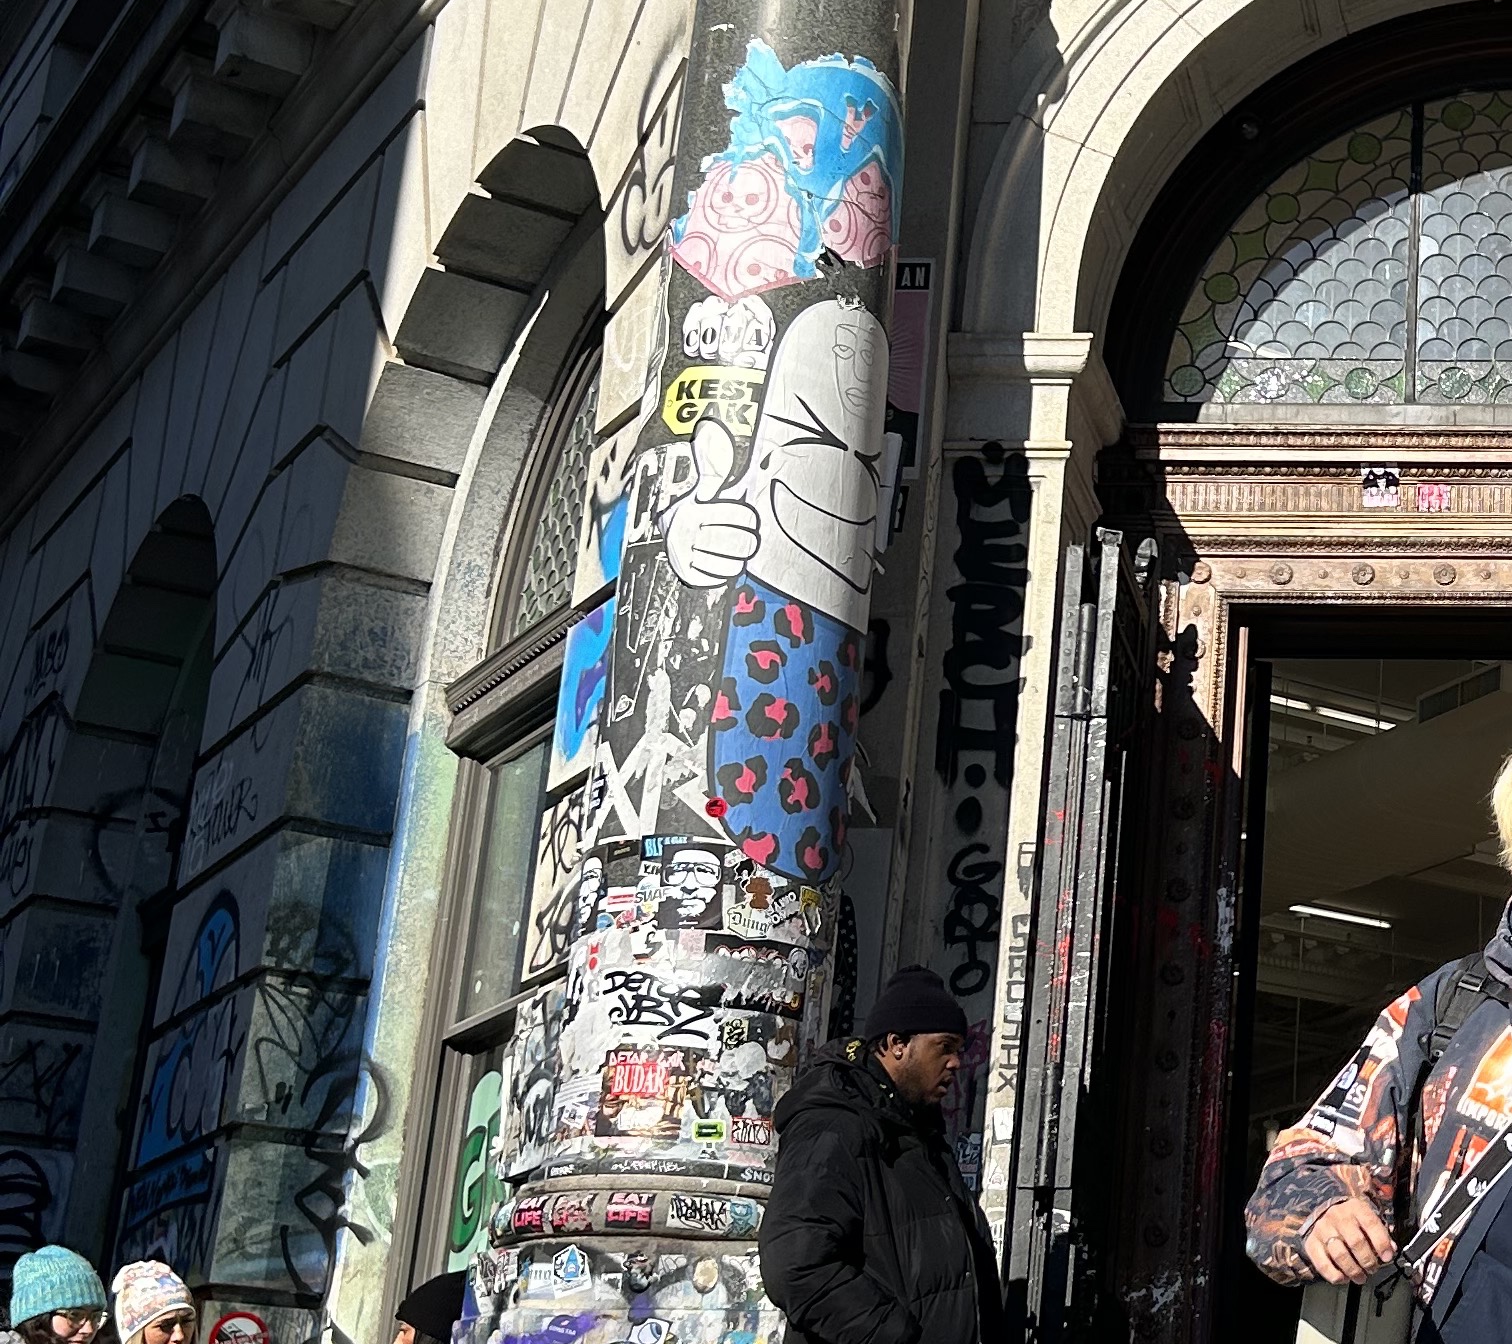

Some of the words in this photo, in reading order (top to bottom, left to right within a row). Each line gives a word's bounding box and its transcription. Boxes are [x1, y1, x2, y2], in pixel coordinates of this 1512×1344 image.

[675, 378, 764, 402] KEST
[675, 401, 754, 426] GAK
[613, 1063, 668, 1095] BUDAR
